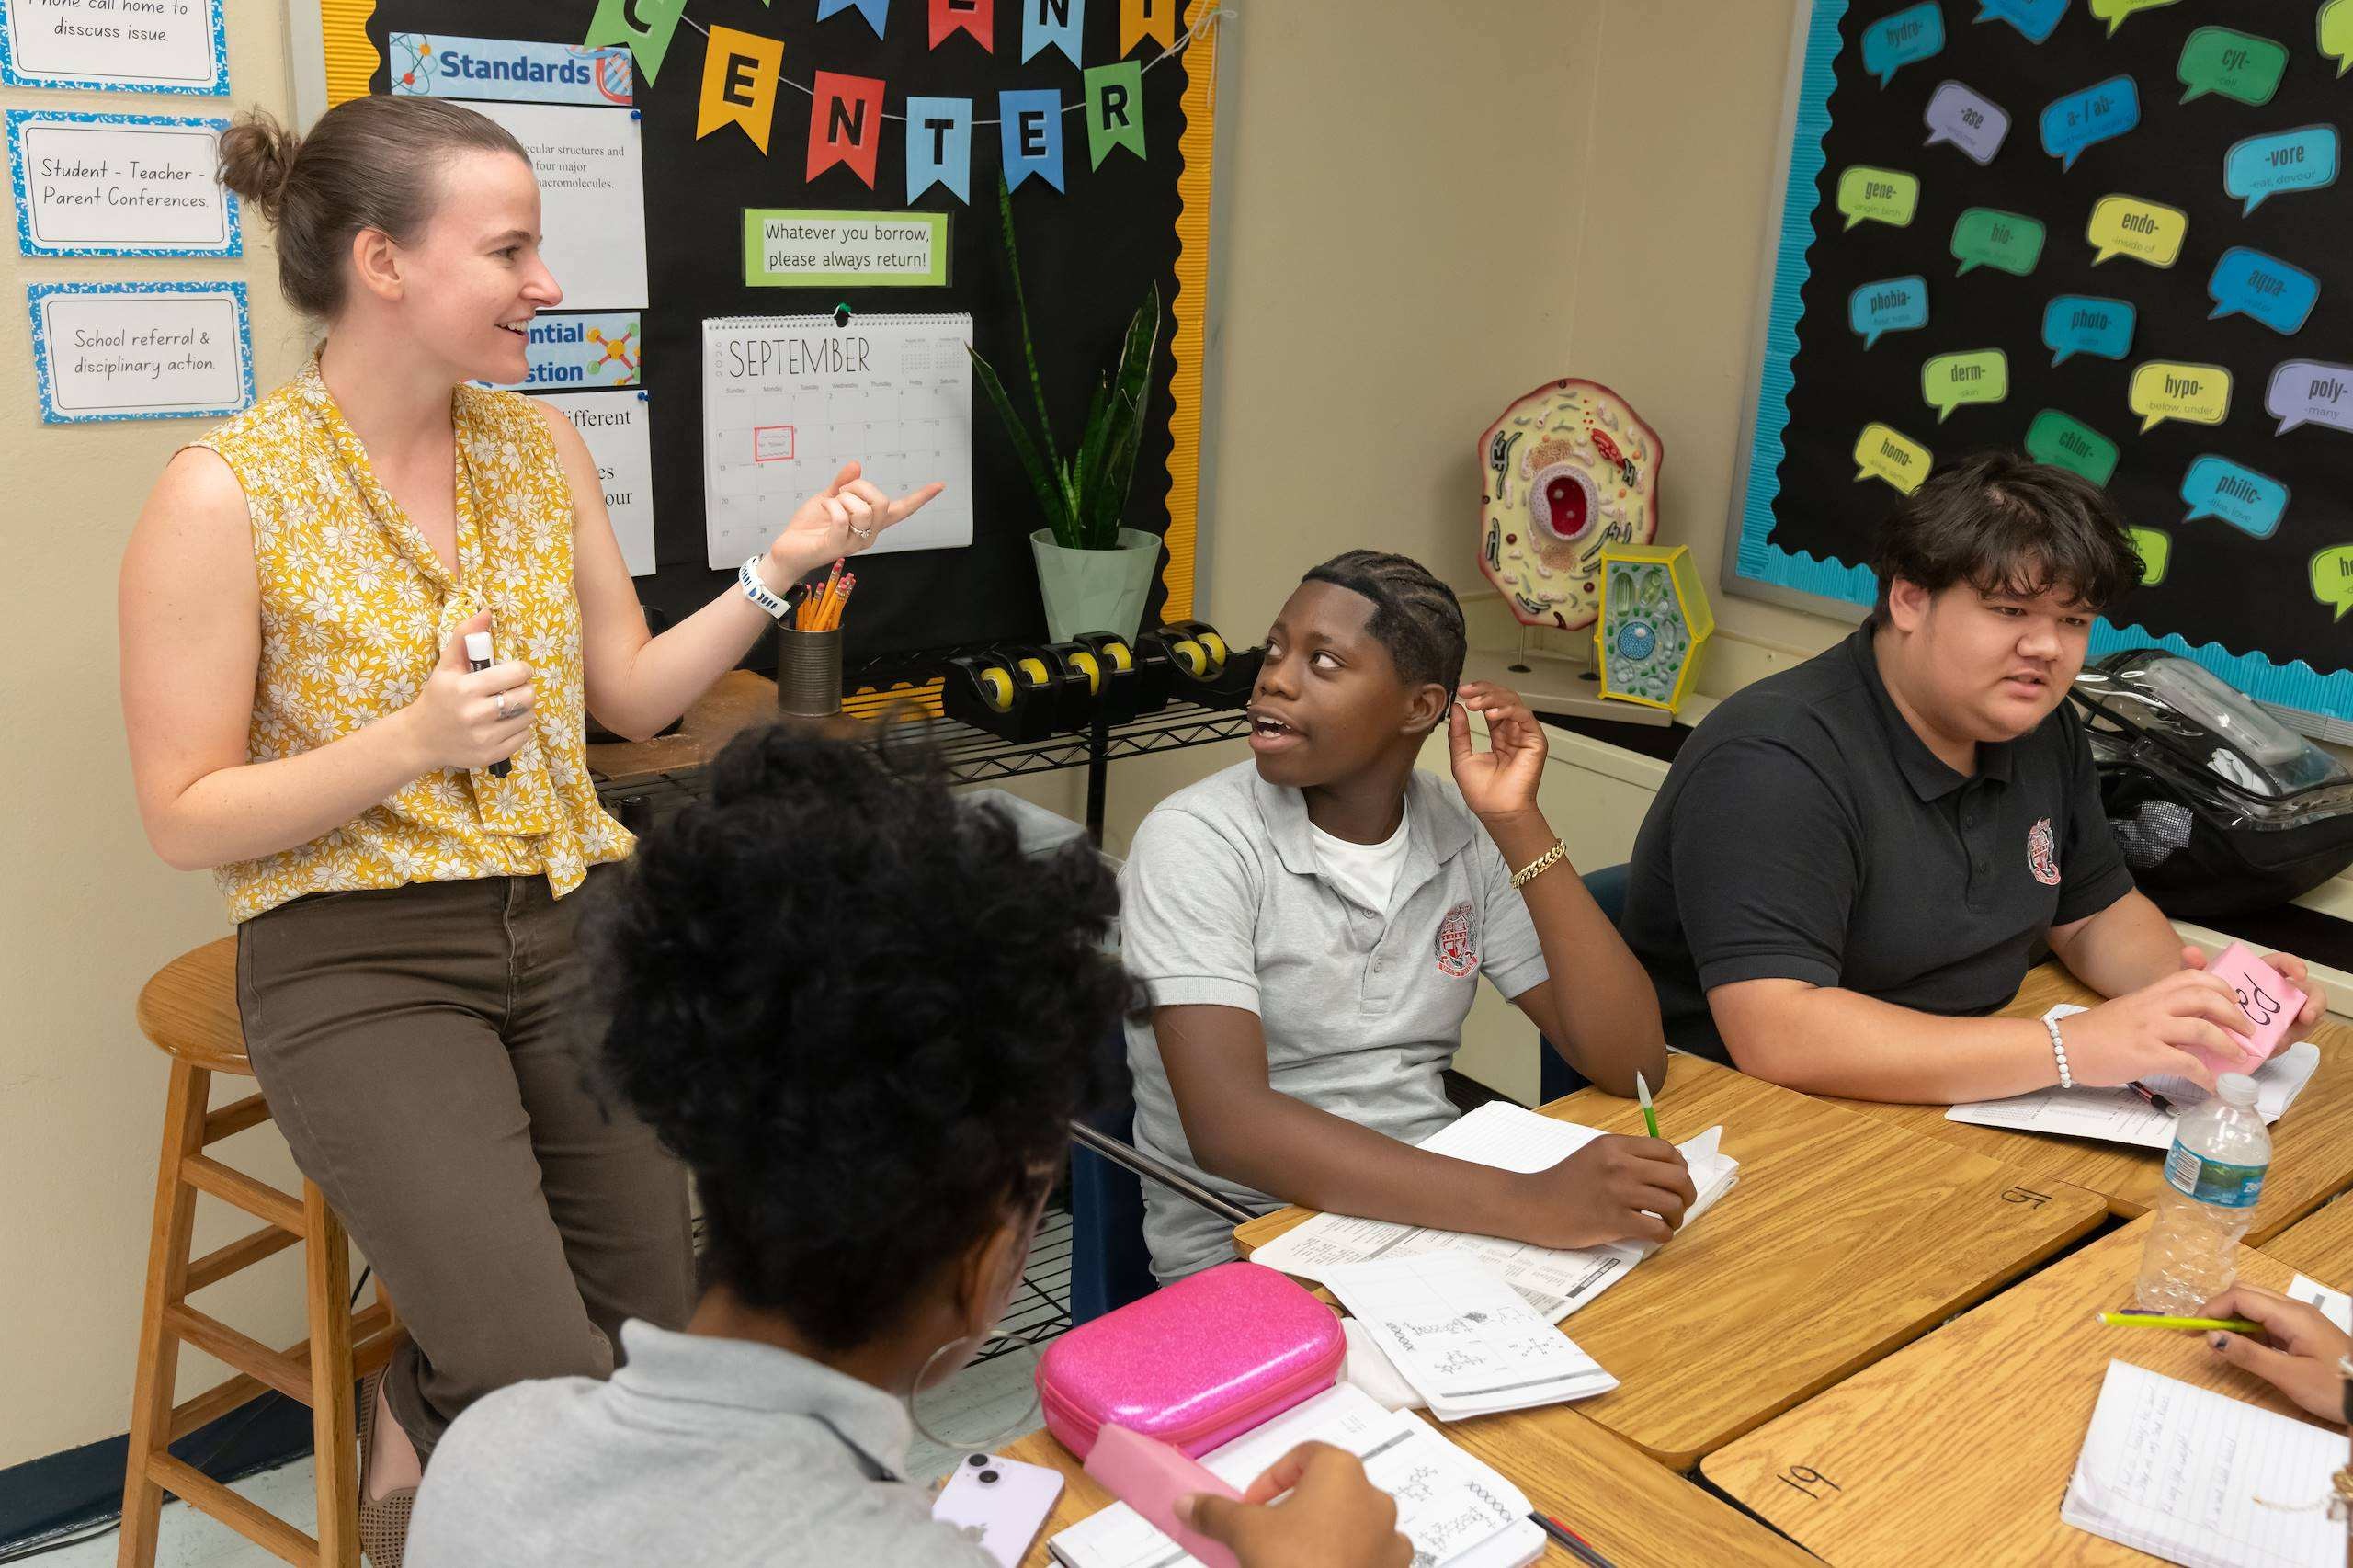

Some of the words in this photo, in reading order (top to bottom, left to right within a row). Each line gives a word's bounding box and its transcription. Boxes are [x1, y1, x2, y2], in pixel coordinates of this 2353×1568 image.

[89, 0, 115, 10] call
[123, 0, 164, 14] home
[173, 0, 188, 16] to
[54, 16, 120, 38] disscuss
[128, 24, 169, 42] issue.
[439, 51, 591, 85] Standards
[2222, 46, 2251, 71] cyt-
[1961, 108, 1984, 130] -ase
[521, 143, 555, 154] ecular
[557, 144, 605, 155] structures
[607, 145, 625, 156] and
[2265, 143, 2305, 168] -vore
[41, 158, 108, 178] Student
[130, 160, 192, 181] Teacher
[536, 160, 557, 171] four
[559, 161, 588, 175] major
[43, 186, 101, 206] Parent
[108, 186, 210, 209] Conferences.
[1865, 181, 1897, 199] gene-
[765, 223, 836, 241] Whatever
[842, 228, 869, 244] you
[874, 224, 930, 244] borrow,
[1991, 222, 2014, 244] bio-
[2121, 212, 2159, 235] endo-
[769, 251, 816, 271] please
[822, 251, 870, 270] always
[876, 253, 926, 267] return!
[2247, 268, 2287, 297] aqua-
[1870, 289, 1911, 314] phobia-
[2072, 309, 2112, 331] photo-
[74, 328, 126, 347] School
[131, 327, 194, 347] referral
[199, 331, 210, 346] &
[530, 322, 584, 344] ntial
[74, 356, 161, 381] disciplinary
[167, 353, 216, 372] action.
[728, 336, 870, 379] SEPTEMBER
[525, 361, 584, 383] stion
[1950, 363, 1986, 382] derm-
[2165, 374, 2203, 399] hypo-
[2308, 377, 2347, 403] poly-
[563, 407, 631, 427] ifferent
[1880, 437, 1913, 467] homo-
[2058, 429, 2094, 459] chlor-
[598, 467, 615, 480] es
[604, 492, 633, 506] our
[2214, 474, 2262, 504] philic-
